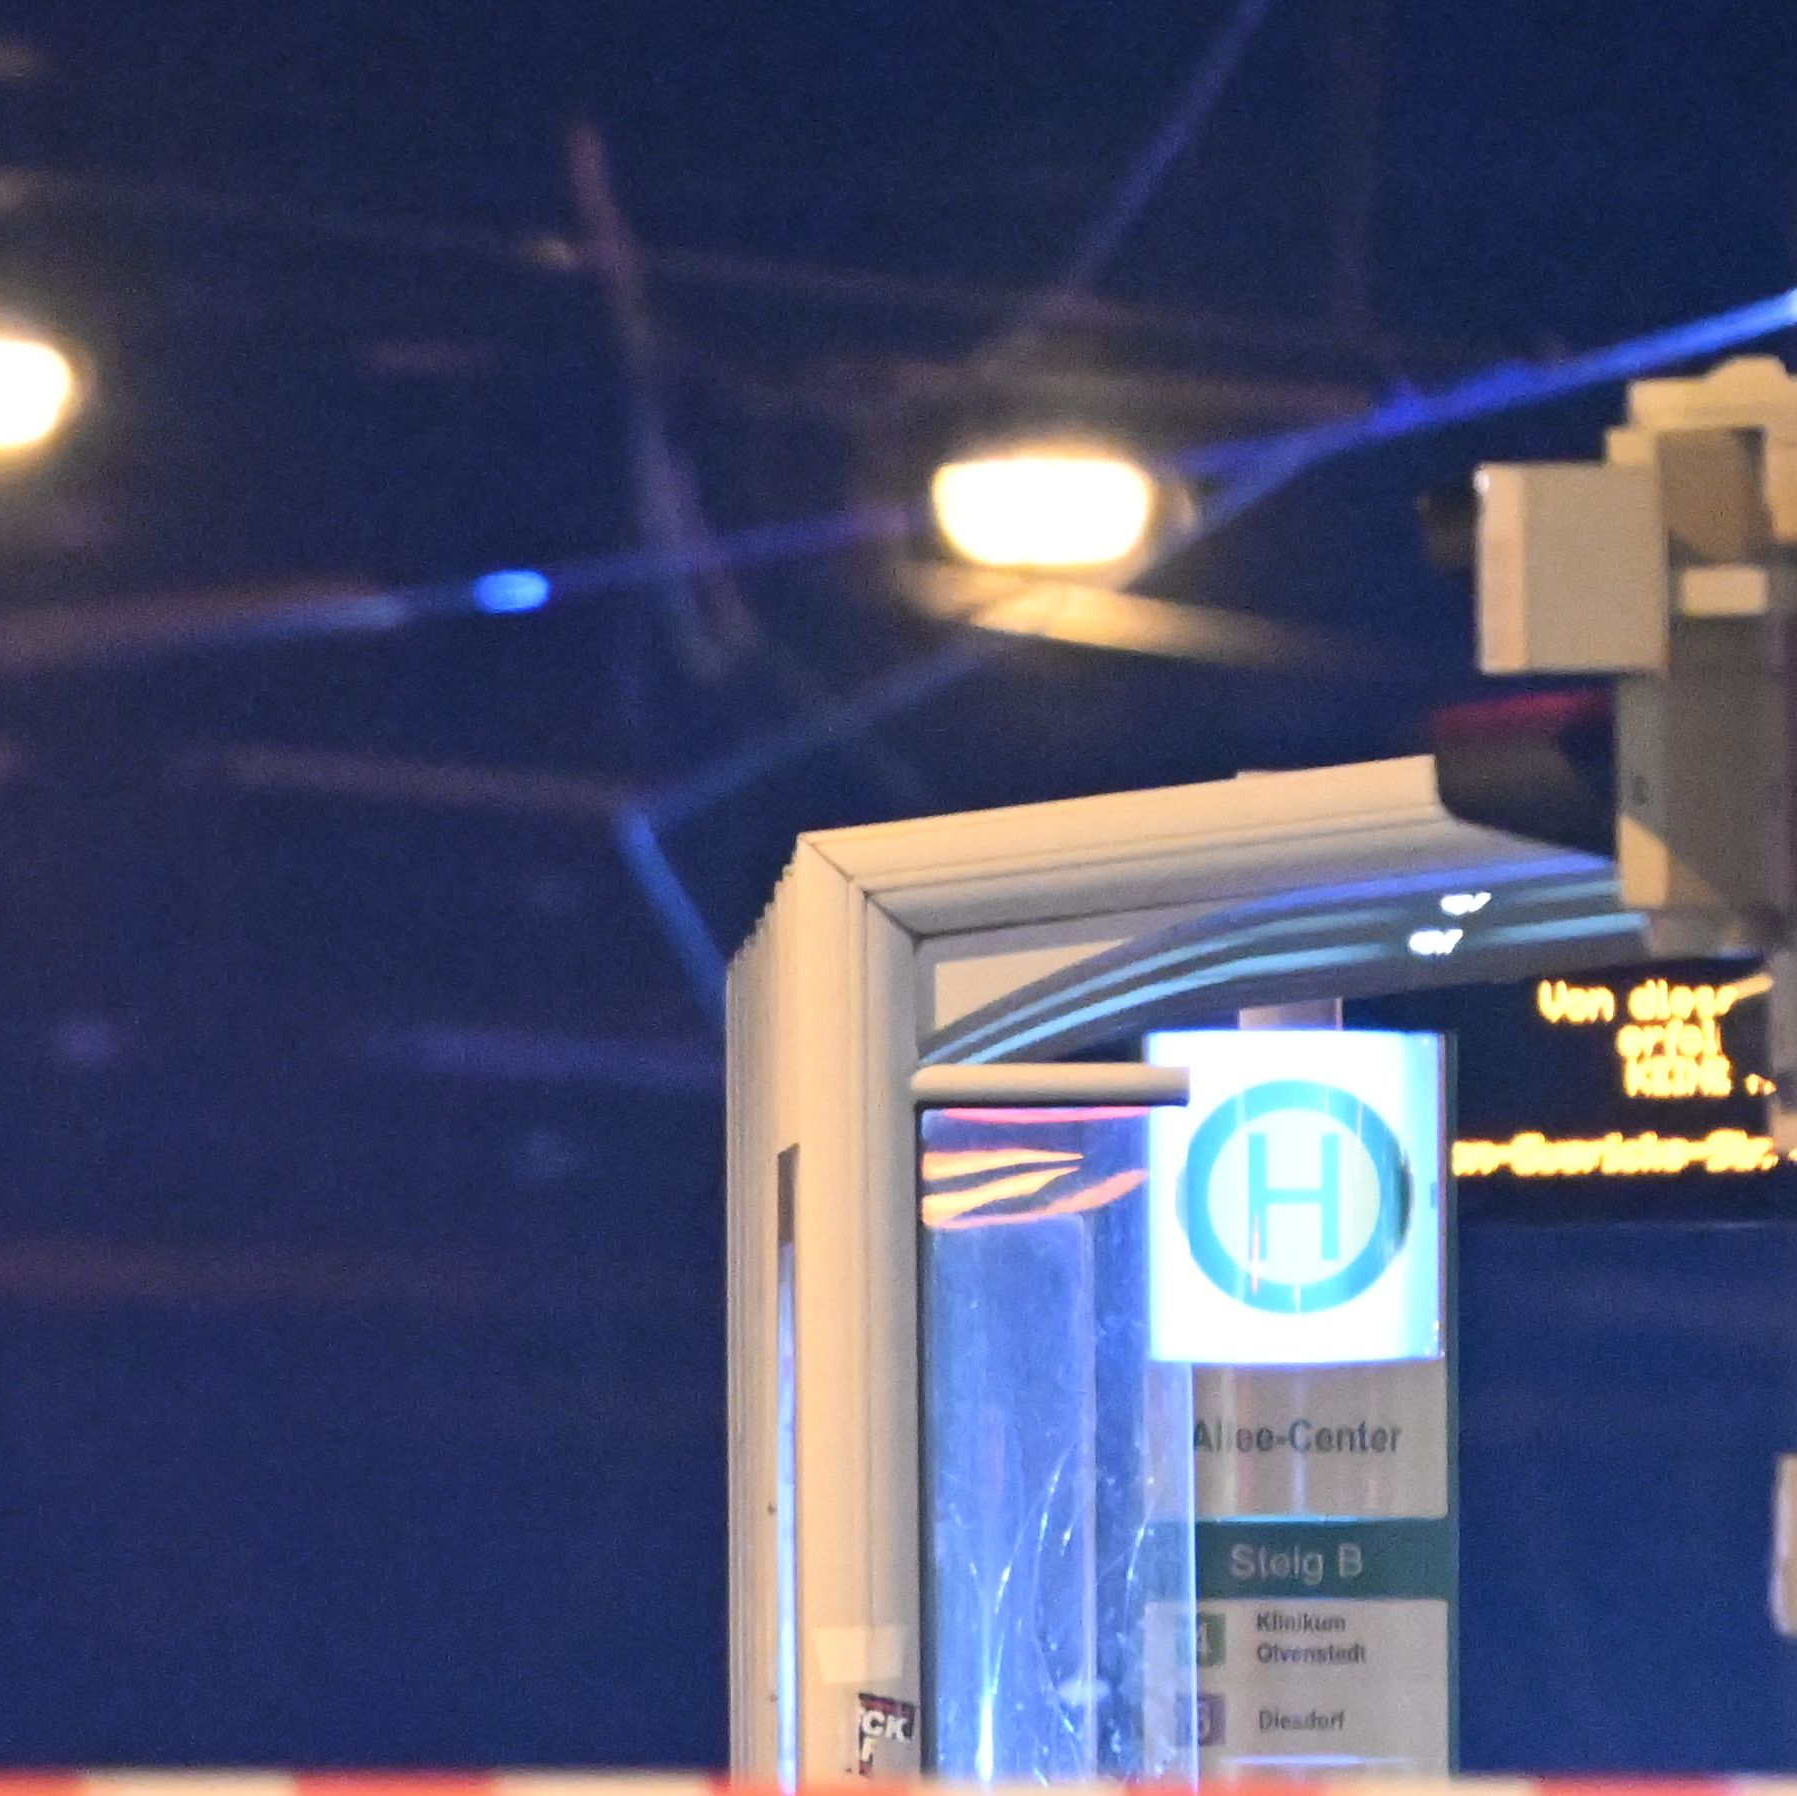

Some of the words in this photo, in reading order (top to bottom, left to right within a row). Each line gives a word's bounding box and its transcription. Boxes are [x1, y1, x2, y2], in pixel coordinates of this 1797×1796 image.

[1193, 1418, 1402, 1453] Alee-Center
[1228, 1543, 1324, 1586] Steig
[1337, 1541, 1363, 1579] B
[1256, 1610, 1347, 1633] Klinikum
[1256, 1641, 1367, 1665] Olvenstedt
[1258, 1708, 1345, 1733] Diesdorf
